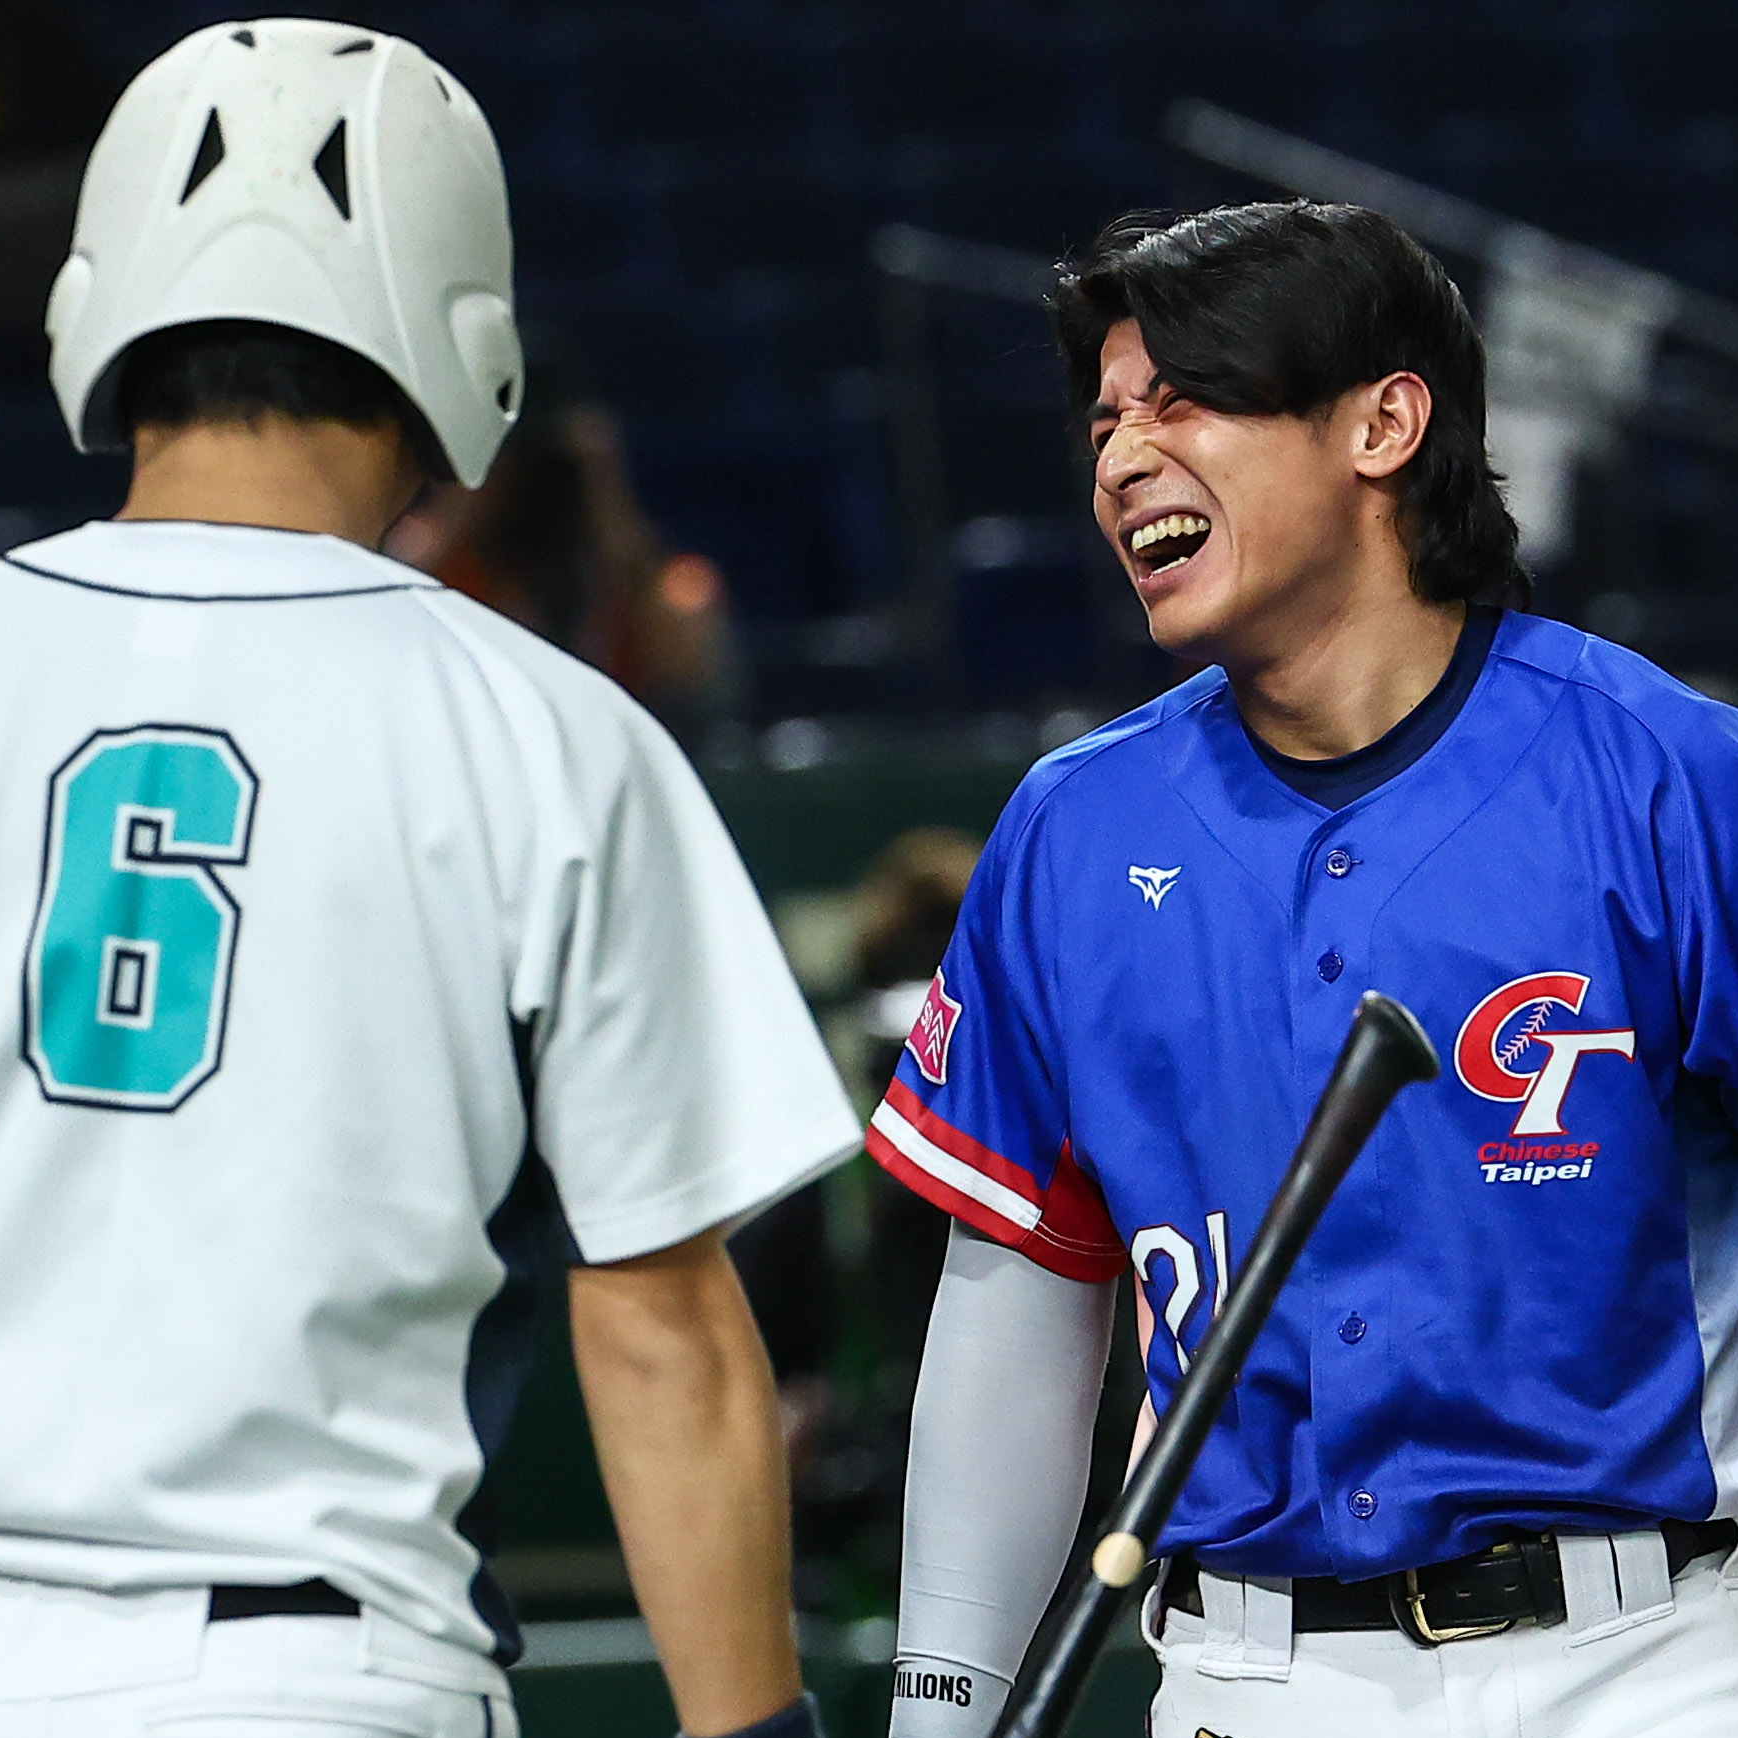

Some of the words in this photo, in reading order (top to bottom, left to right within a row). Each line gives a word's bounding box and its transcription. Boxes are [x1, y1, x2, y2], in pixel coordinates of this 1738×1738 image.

[20, 721, 260, 1114] 6
[1478, 1141, 1600, 1162] Chinese
[1480, 1158, 1593, 1185] Taipei
